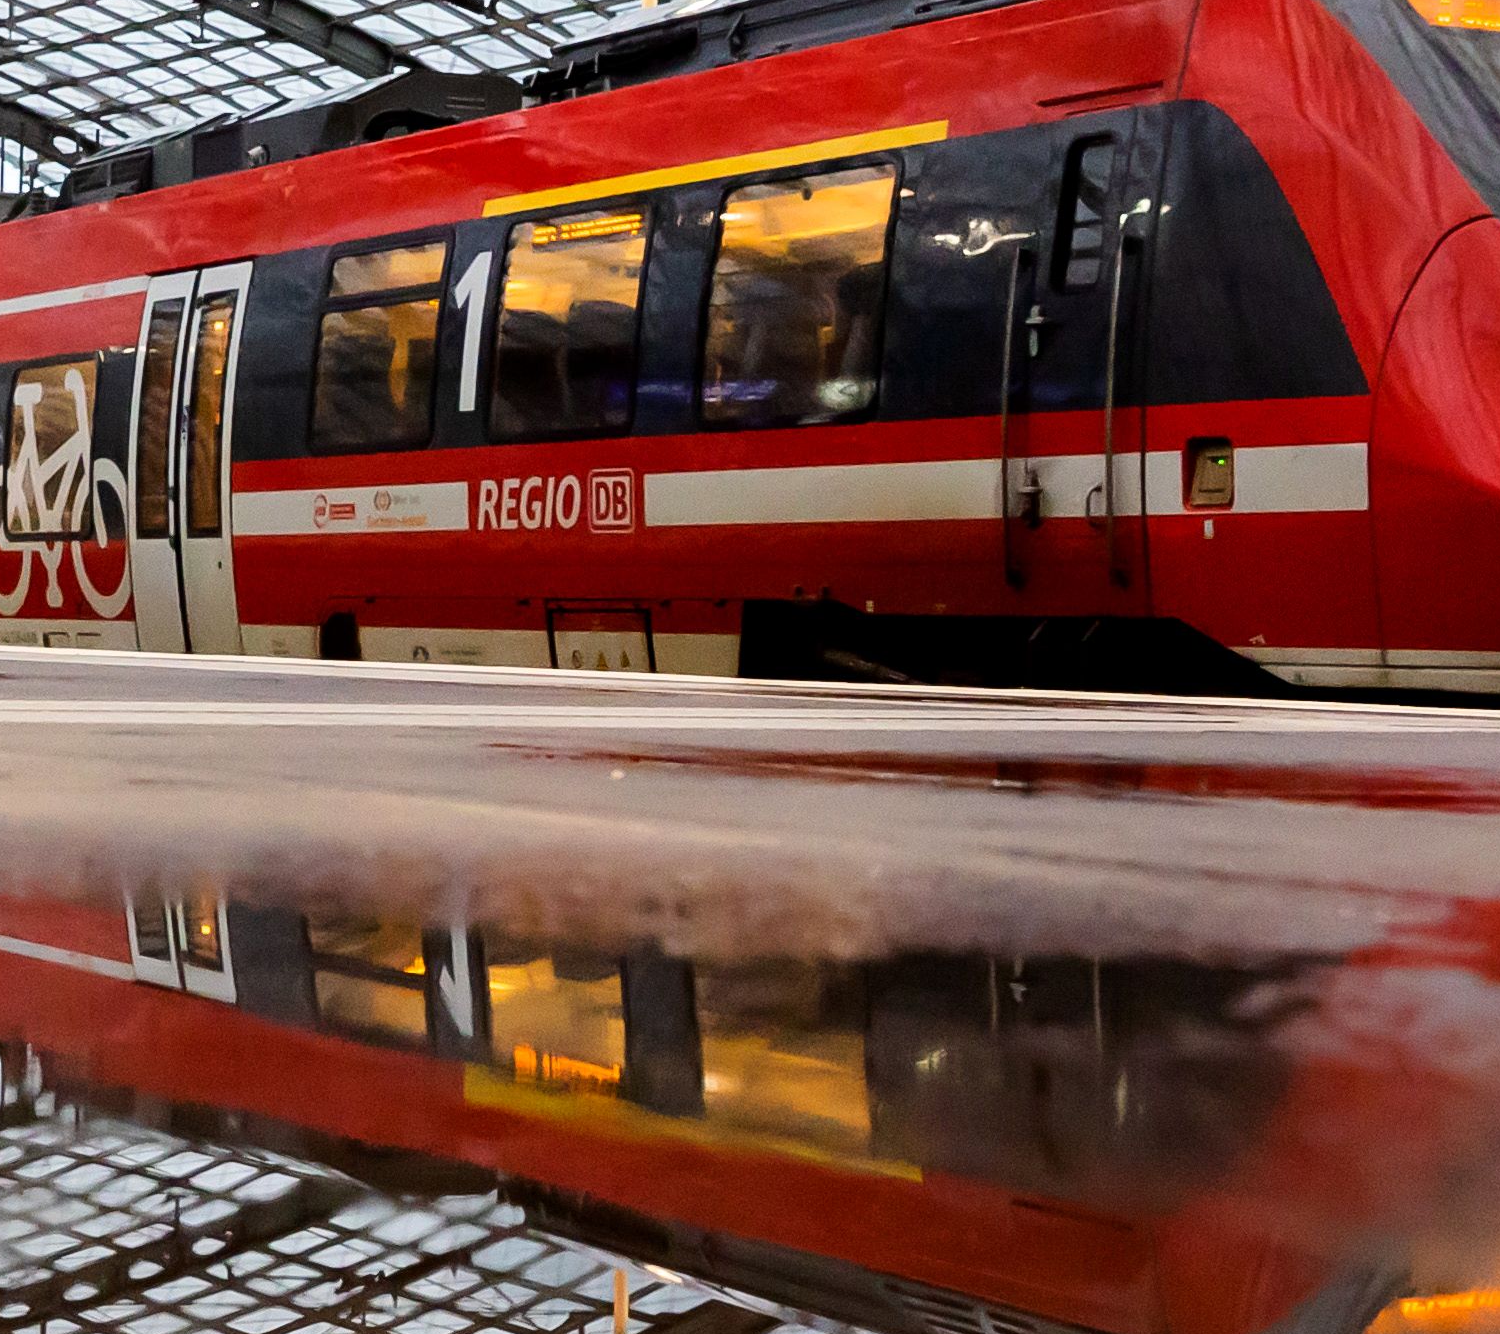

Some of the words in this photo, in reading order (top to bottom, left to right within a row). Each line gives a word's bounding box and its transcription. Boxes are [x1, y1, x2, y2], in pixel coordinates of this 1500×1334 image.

[454, 251, 493, 412] 1
[477, 475, 581, 530] REGIO
[595, 481, 629, 521] DB
